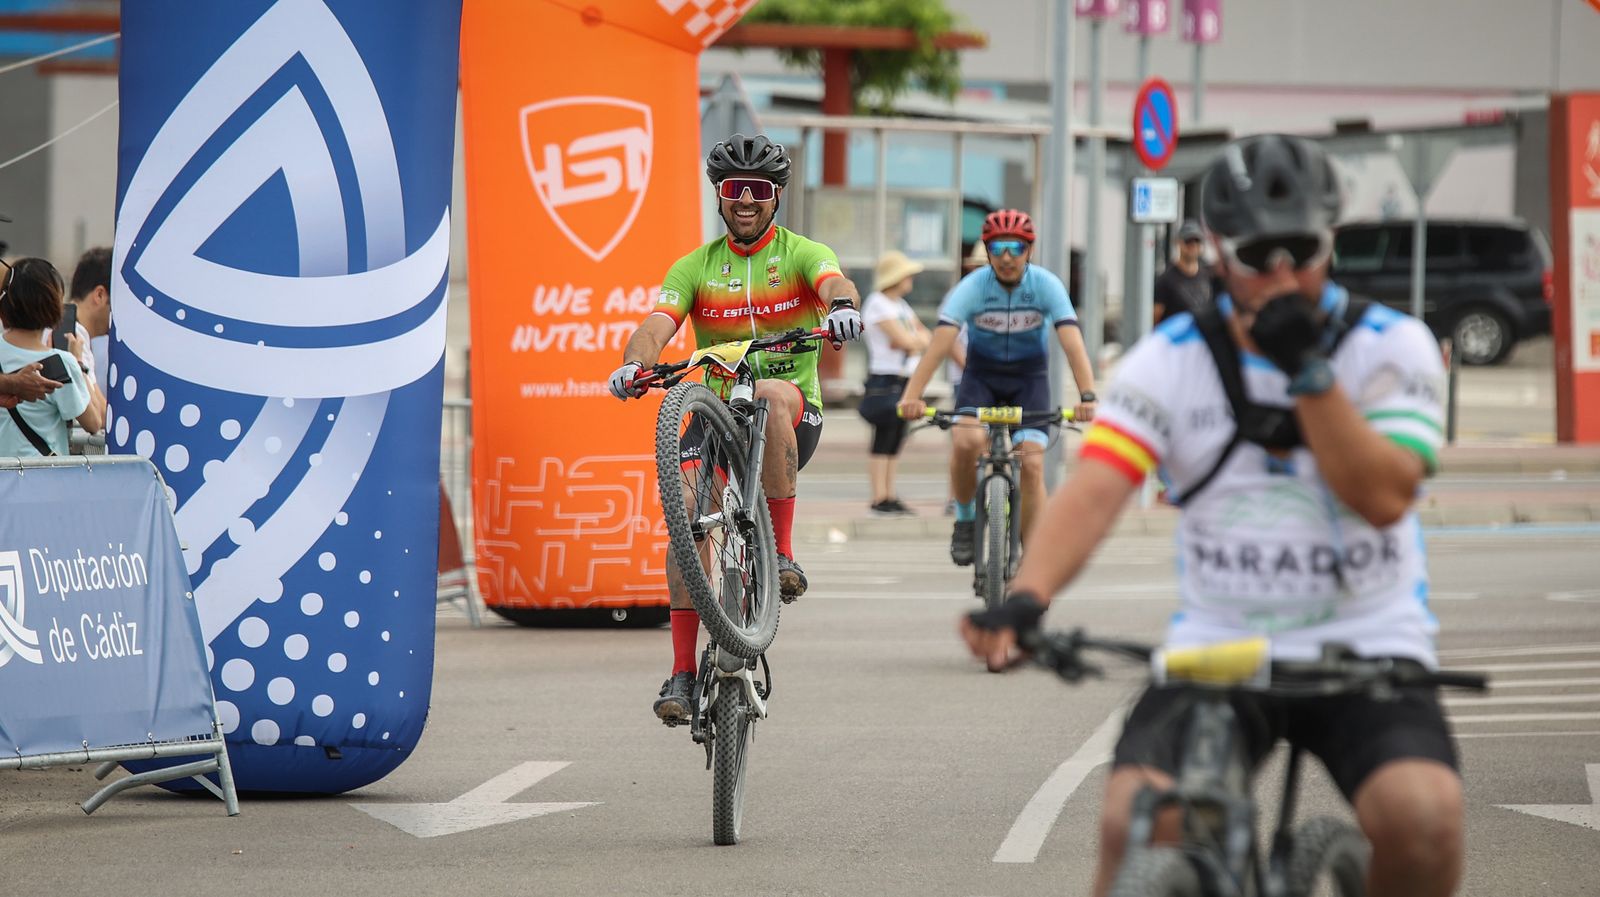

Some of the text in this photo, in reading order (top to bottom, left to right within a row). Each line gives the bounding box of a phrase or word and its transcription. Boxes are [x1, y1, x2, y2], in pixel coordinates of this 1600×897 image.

[532, 283, 594, 316] WE
[723, 305, 771, 318] ESTELLA
[774, 297, 801, 313] BIKE
[510, 320, 687, 353] NUTRIT!
[28, 542, 148, 601] Diputación
[48, 611, 144, 664] de Cádiz
